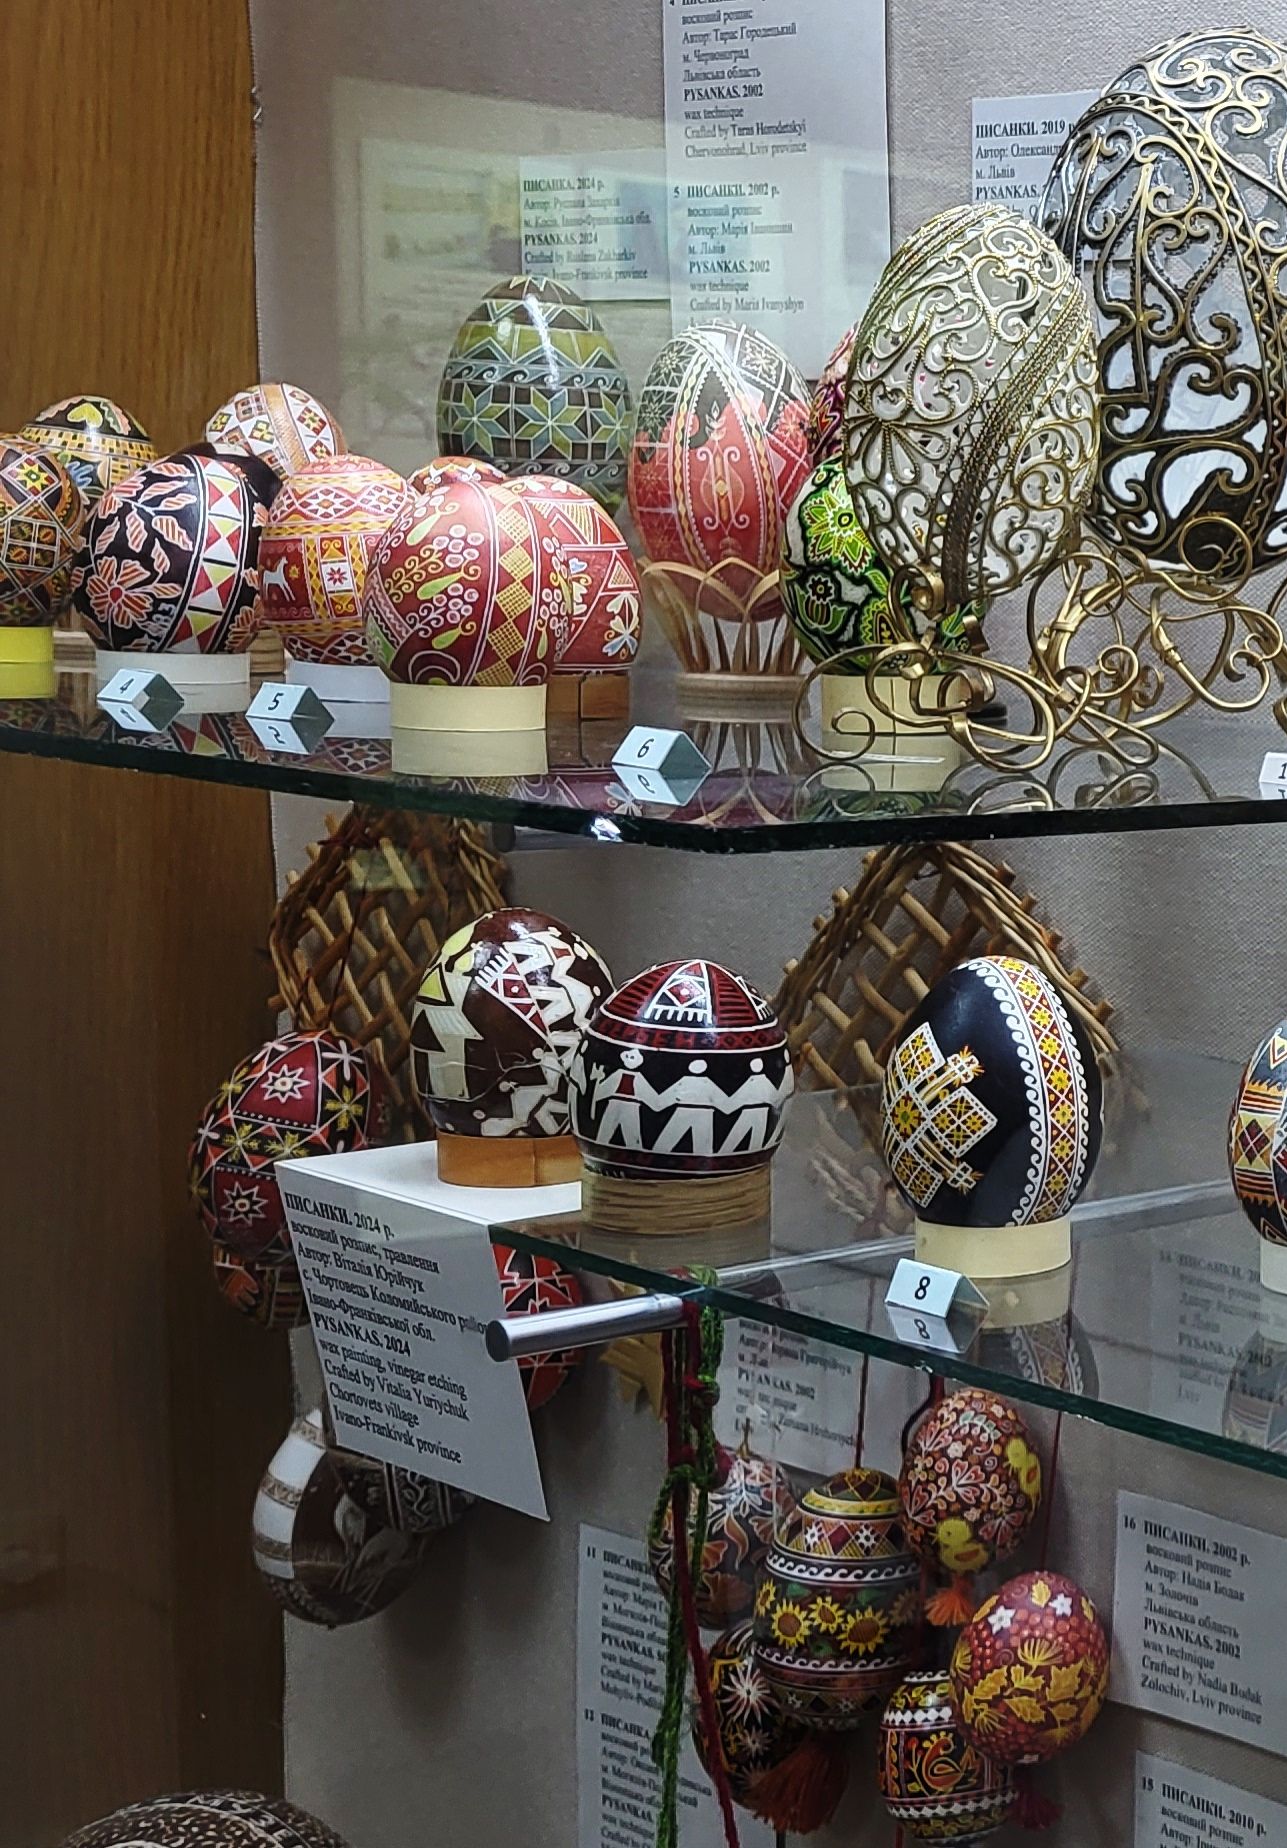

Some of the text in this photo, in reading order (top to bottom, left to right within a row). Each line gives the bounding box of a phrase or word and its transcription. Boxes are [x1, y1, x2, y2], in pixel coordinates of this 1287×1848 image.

[120, 679, 134, 693] 4
[268, 692, 284, 711] 5
[637, 738, 654, 758] 6
[914, 1276, 931, 1300] 8
